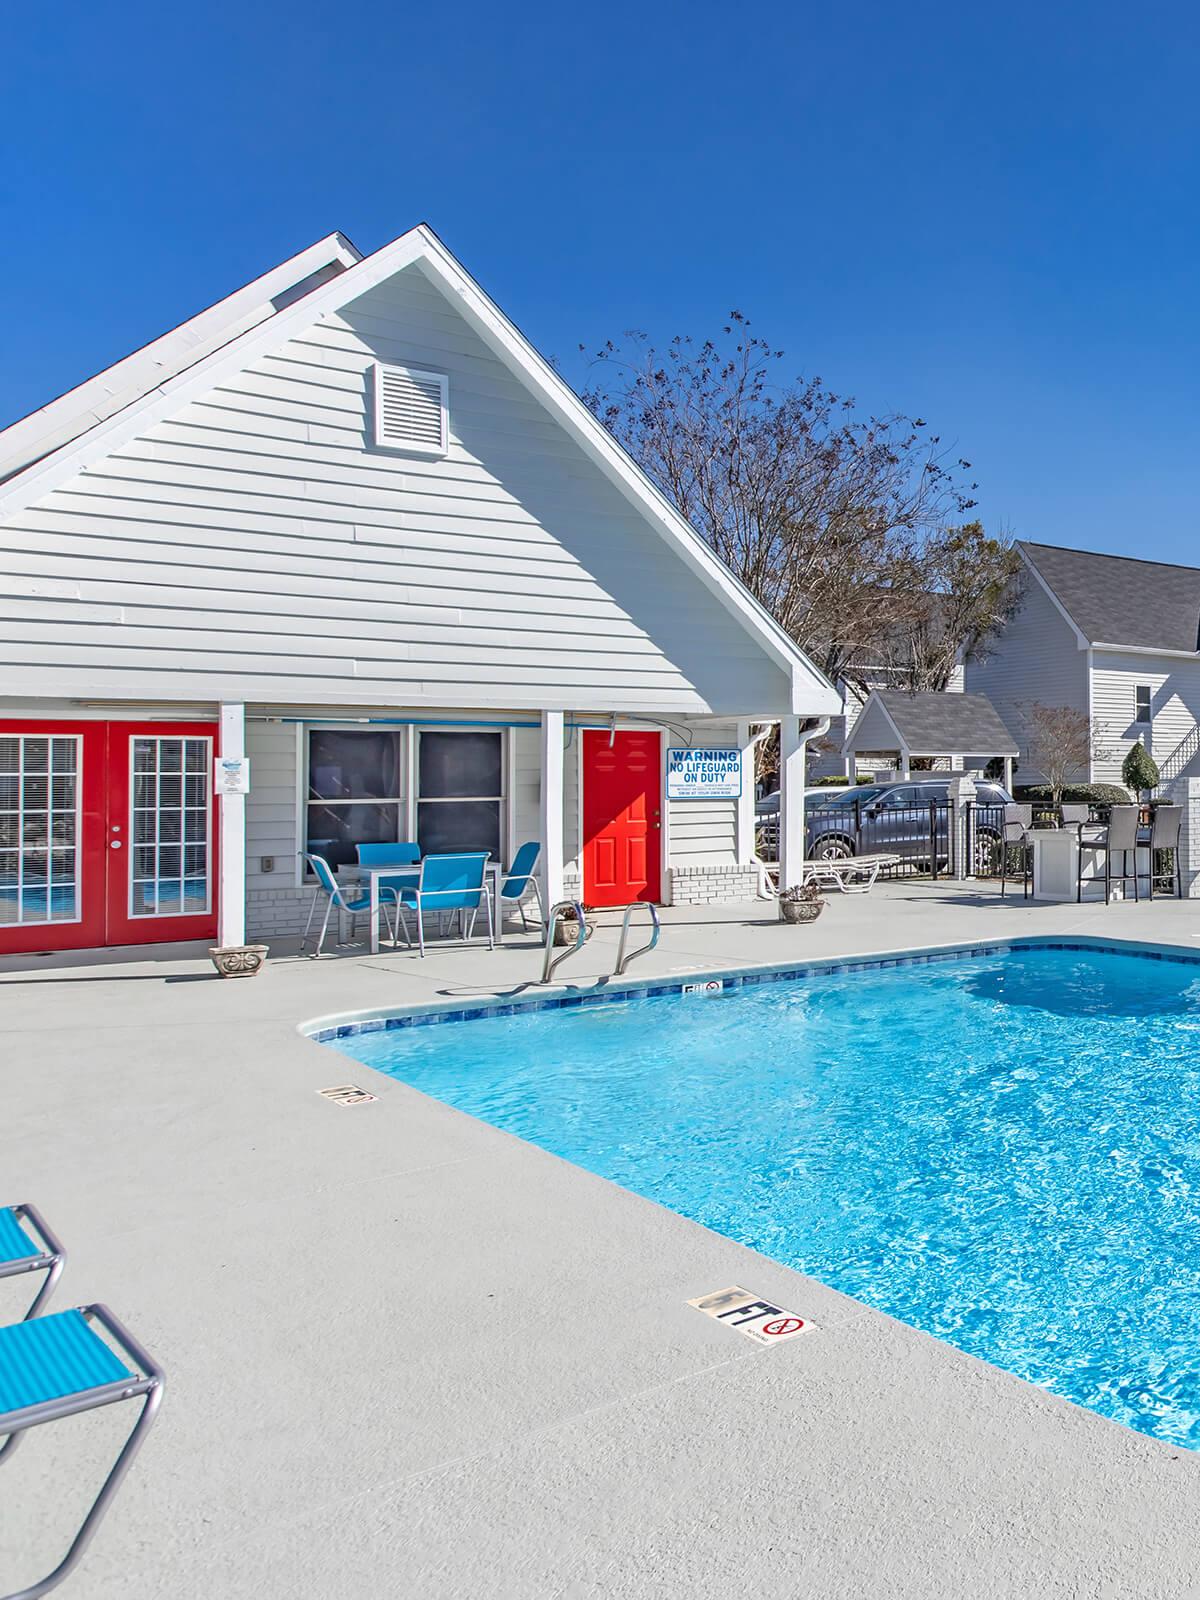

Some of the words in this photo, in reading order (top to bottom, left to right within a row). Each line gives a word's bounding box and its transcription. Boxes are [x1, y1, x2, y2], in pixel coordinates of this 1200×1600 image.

[672, 751, 737, 761] WARNING
[670, 762, 684, 772] NO
[686, 762, 739, 772] LIFEGUARD
[683, 772, 698, 783] ON
[700, 772, 726, 782] DUTY
[717, 1301, 784, 1326] FT
